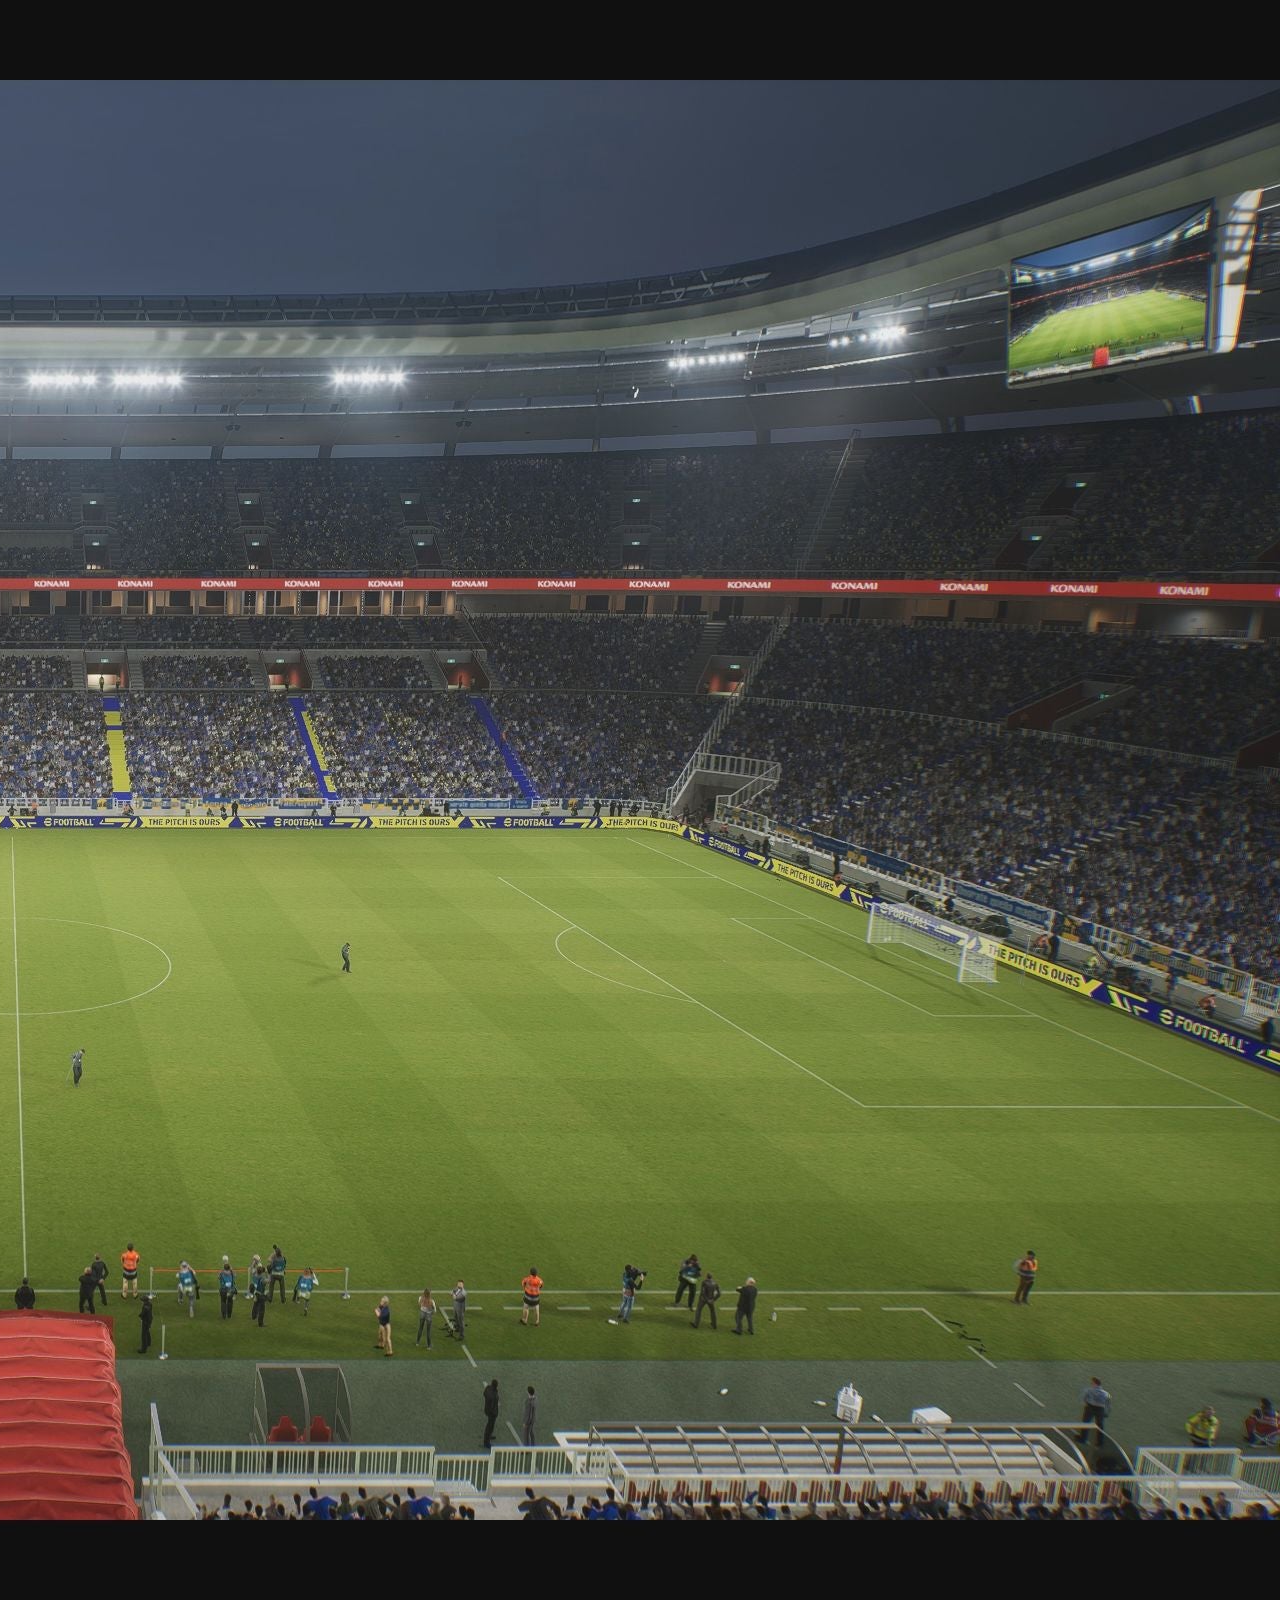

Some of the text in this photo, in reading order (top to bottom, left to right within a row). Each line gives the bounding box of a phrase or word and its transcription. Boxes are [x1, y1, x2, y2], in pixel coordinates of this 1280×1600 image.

[33, 579, 70, 587] KONAMI
[117, 579, 154, 587] KONAMI
[200, 579, 237, 587] KONAMI
[284, 579, 321, 587] KONAMI
[367, 579, 404, 587] KONAMI
[628, 580, 671, 588] KONAMI
[727, 580, 772, 588] KONAMI
[831, 581, 878, 589] KONAMI
[939, 582, 989, 591] KONAMI
[1050, 584, 1098, 593] KONAMI
[1159, 586, 1209, 595] KONAMI
[607, 818, 678, 831] THE PITCH IS OURS
[778, 863, 833, 891] THE PITCH IS OURS
[989, 944, 1080, 988] THE PITCH IS OURS
